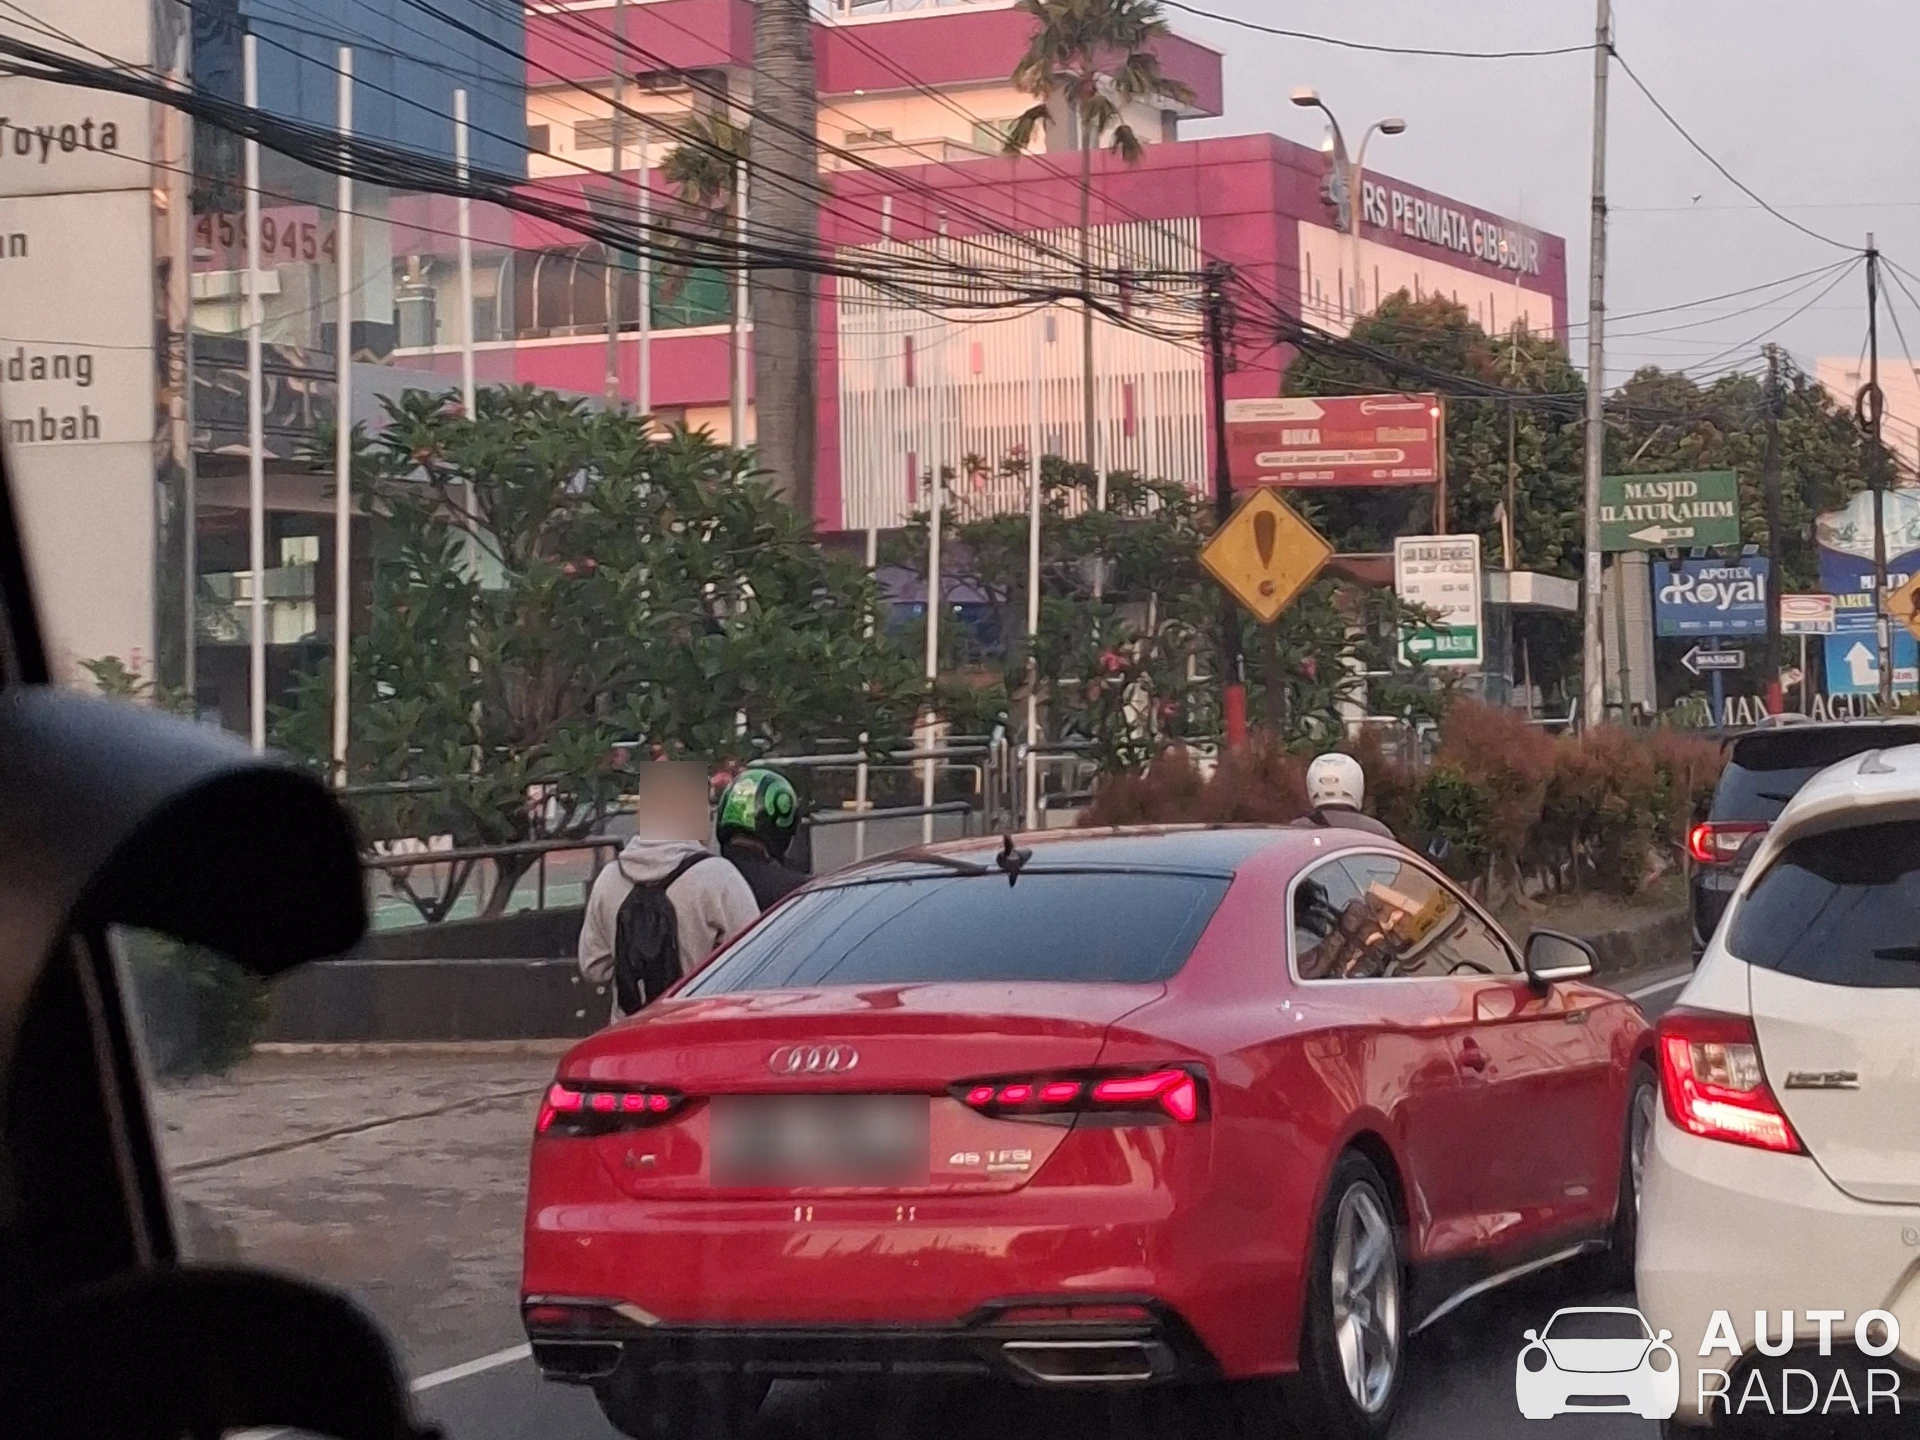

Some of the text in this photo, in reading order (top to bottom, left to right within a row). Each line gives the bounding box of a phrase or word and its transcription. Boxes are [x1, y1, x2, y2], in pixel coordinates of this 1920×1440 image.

[1362, 180, 1541, 276] RS PERMATA CIBUBUR
[0, 233, 28, 258] n
[0, 346, 93, 387] dang
[4, 404, 100, 443] mbah
[1623, 480, 1698, 502] MASJID
[1599, 500, 1735, 524] ILATURAHIM
[1698, 566, 1753, 580] APOTEK
[1659, 572, 1765, 611] Royal
